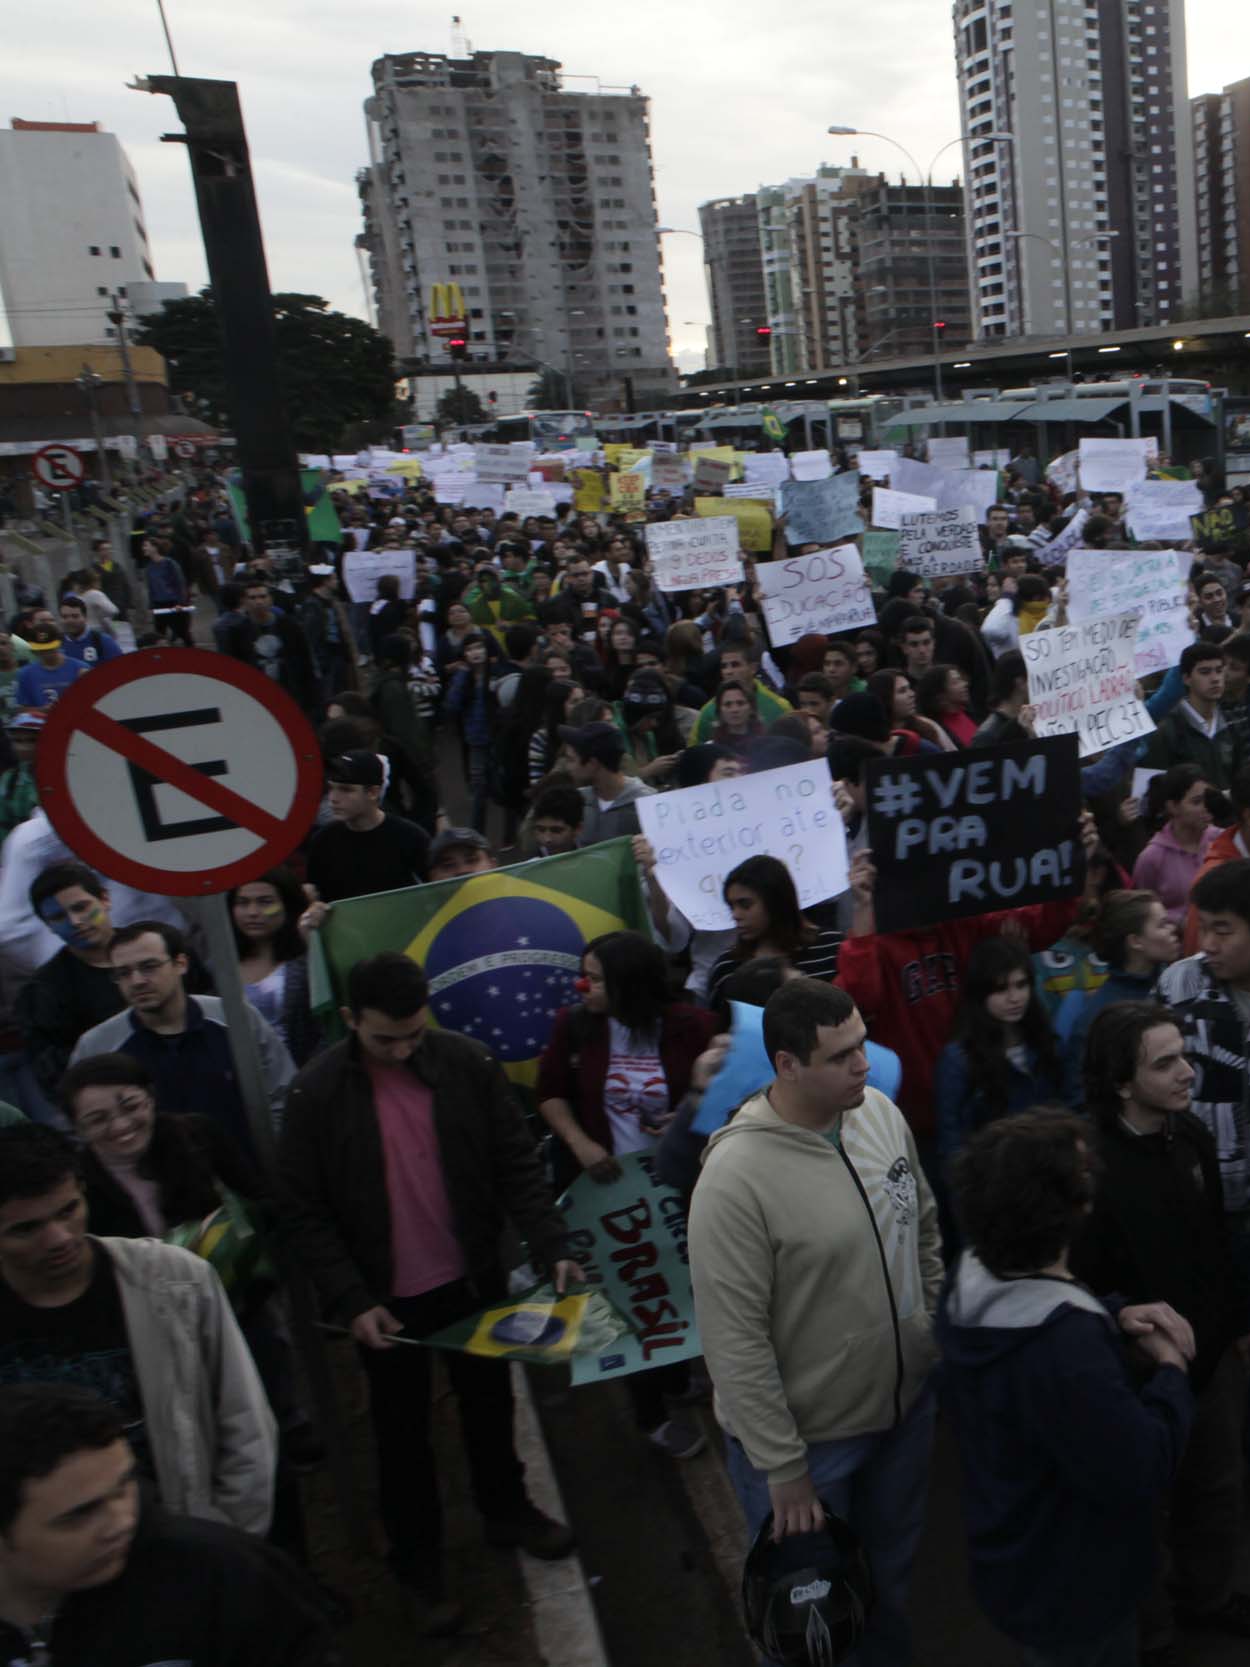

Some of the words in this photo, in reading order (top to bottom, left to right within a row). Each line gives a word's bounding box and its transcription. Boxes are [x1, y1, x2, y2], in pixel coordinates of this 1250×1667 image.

[782, 549, 846, 589] SOS
[655, 785, 746, 829] Piada
[775, 777, 816, 801] no
[871, 754, 1048, 819] #VEM
[658, 821, 764, 866] exterior
[895, 814, 987, 861] PRA
[949, 838, 1074, 904] RUA!
